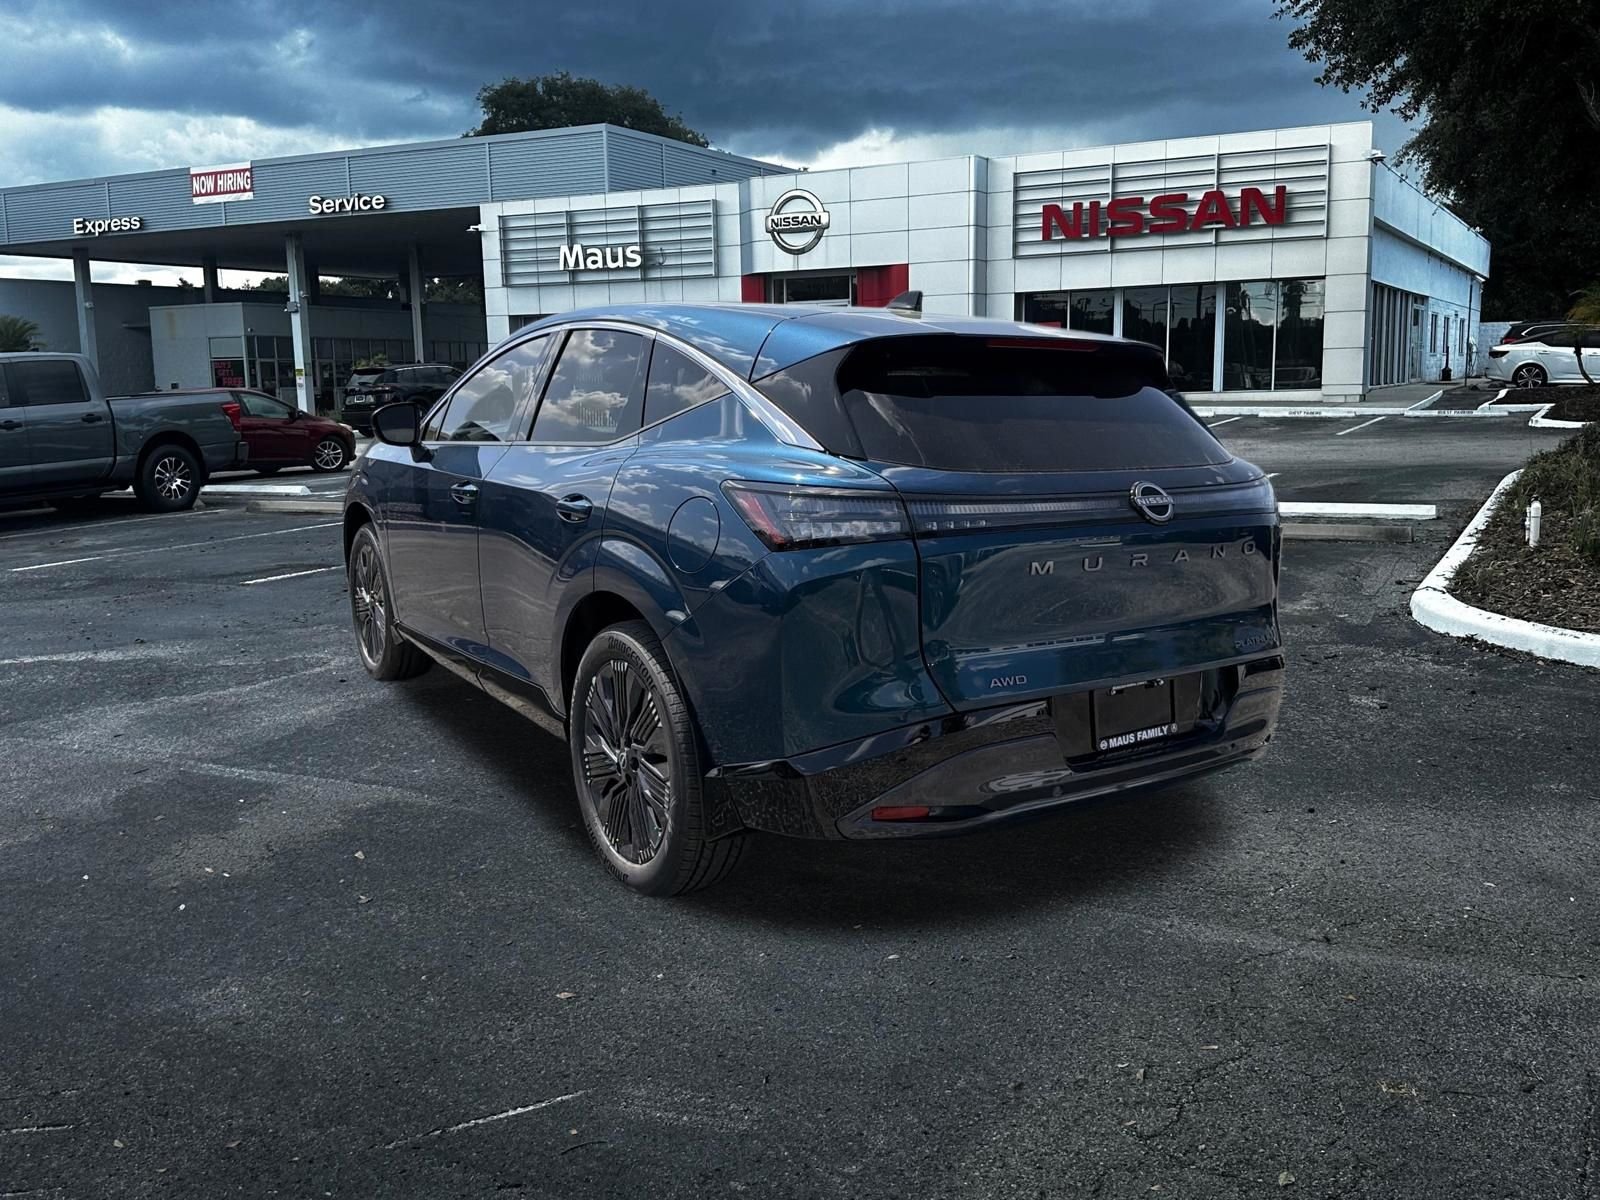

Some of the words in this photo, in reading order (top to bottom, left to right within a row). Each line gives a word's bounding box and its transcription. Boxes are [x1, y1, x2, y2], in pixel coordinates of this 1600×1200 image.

[193, 174, 215, 195] NOW
[217, 171, 251, 192] HIRING
[309, 193, 385, 214] Service
[1041, 185, 1287, 241] NISSAN
[73, 216, 141, 236] Express
[770, 215, 822, 228] NISSAN
[560, 244, 642, 270] Maus
[1136, 497, 1173, 505] NISSAN
[1029, 537, 1256, 576] MURANO
[990, 675, 1027, 688] AWD
[1109, 733, 1135, 748] MAUS
[1137, 725, 1169, 741] FAMILY
